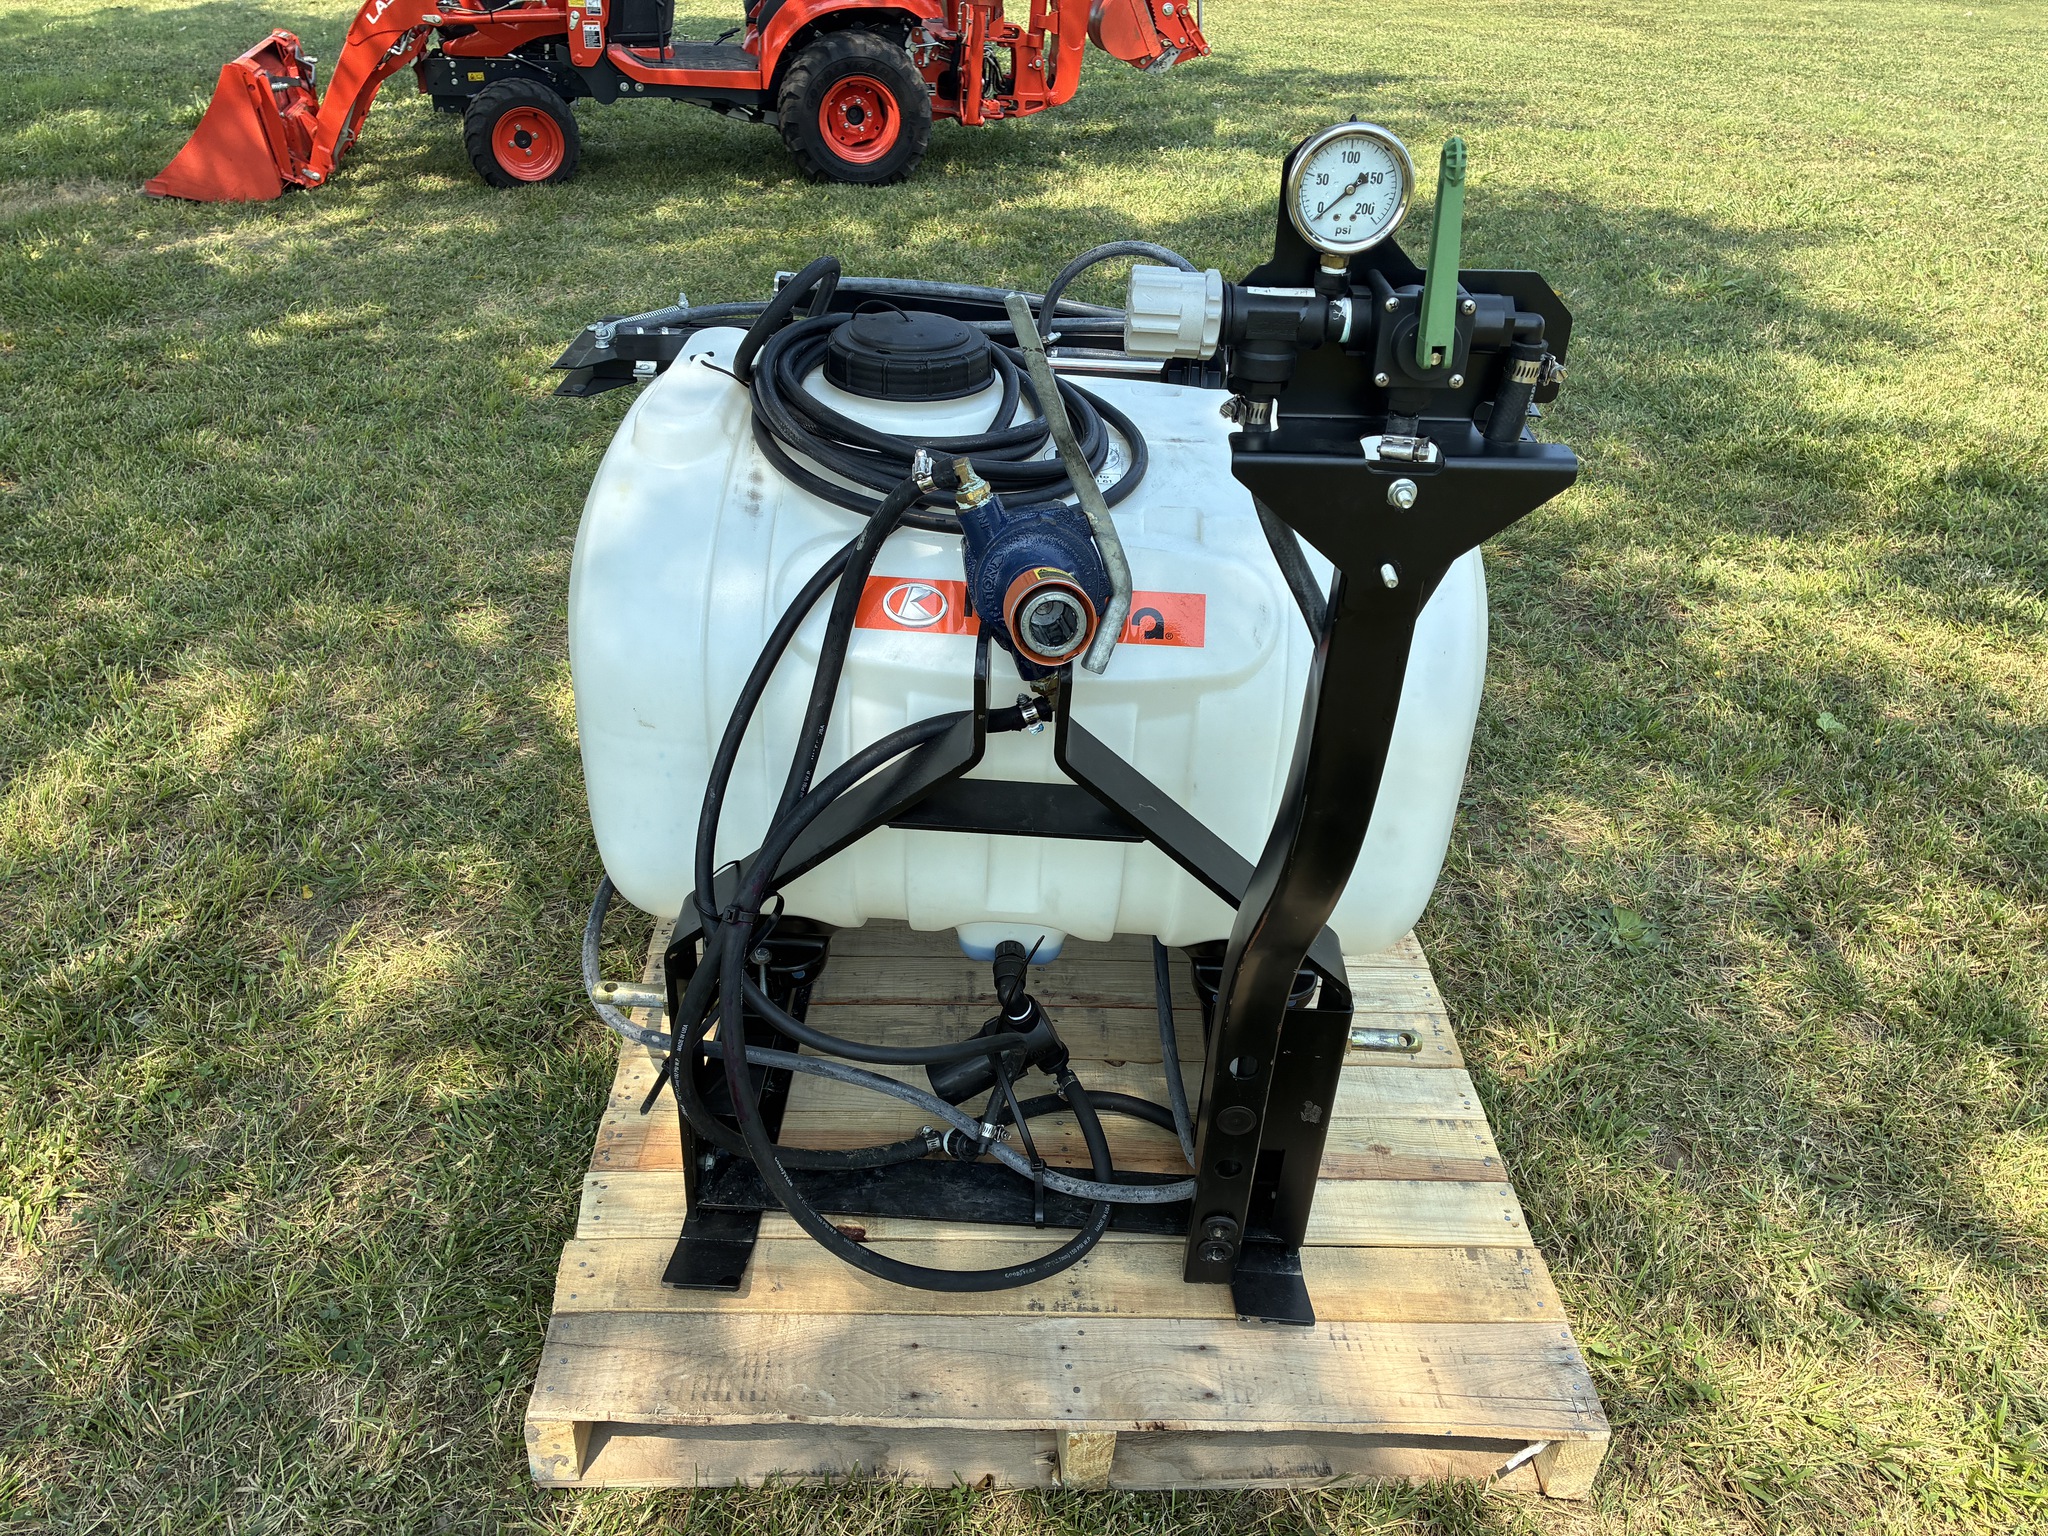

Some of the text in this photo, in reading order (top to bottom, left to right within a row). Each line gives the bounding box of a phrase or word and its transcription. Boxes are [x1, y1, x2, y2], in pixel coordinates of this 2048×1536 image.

[366, 0, 395, 25] LA
[1341, 151, 1361, 164] 100
[1316, 173, 1329, 186] 50
[1317, 201, 1324, 214] 0
[1355, 202, 1374, 215] 200
[1335, 225, 1352, 237] psi
[1094, 1218, 1106, 1232] MADE
